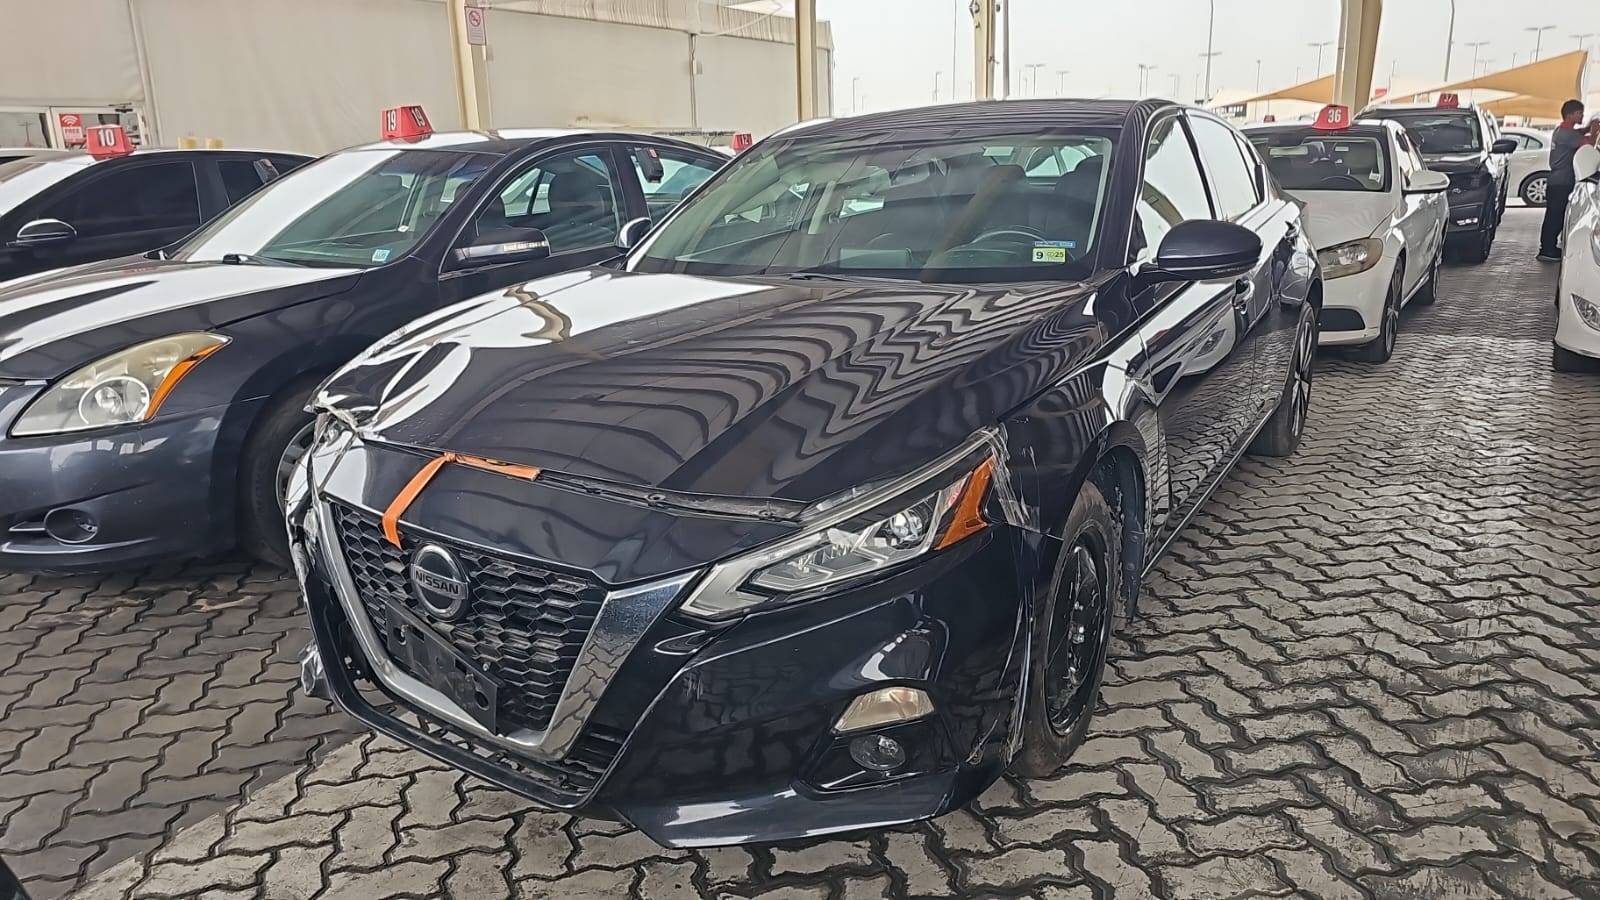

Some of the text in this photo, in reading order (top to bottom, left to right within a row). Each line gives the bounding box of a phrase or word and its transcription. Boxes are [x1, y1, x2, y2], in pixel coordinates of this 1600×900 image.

[388, 110, 396, 131] 19
[411, 107, 425, 127] 19
[1327, 109, 1342, 123] 36
[99, 129, 115, 146] 10
[741, 135, 749, 144] 12
[1036, 251, 1044, 259] 9
[416, 570, 459, 595] NISSAN
